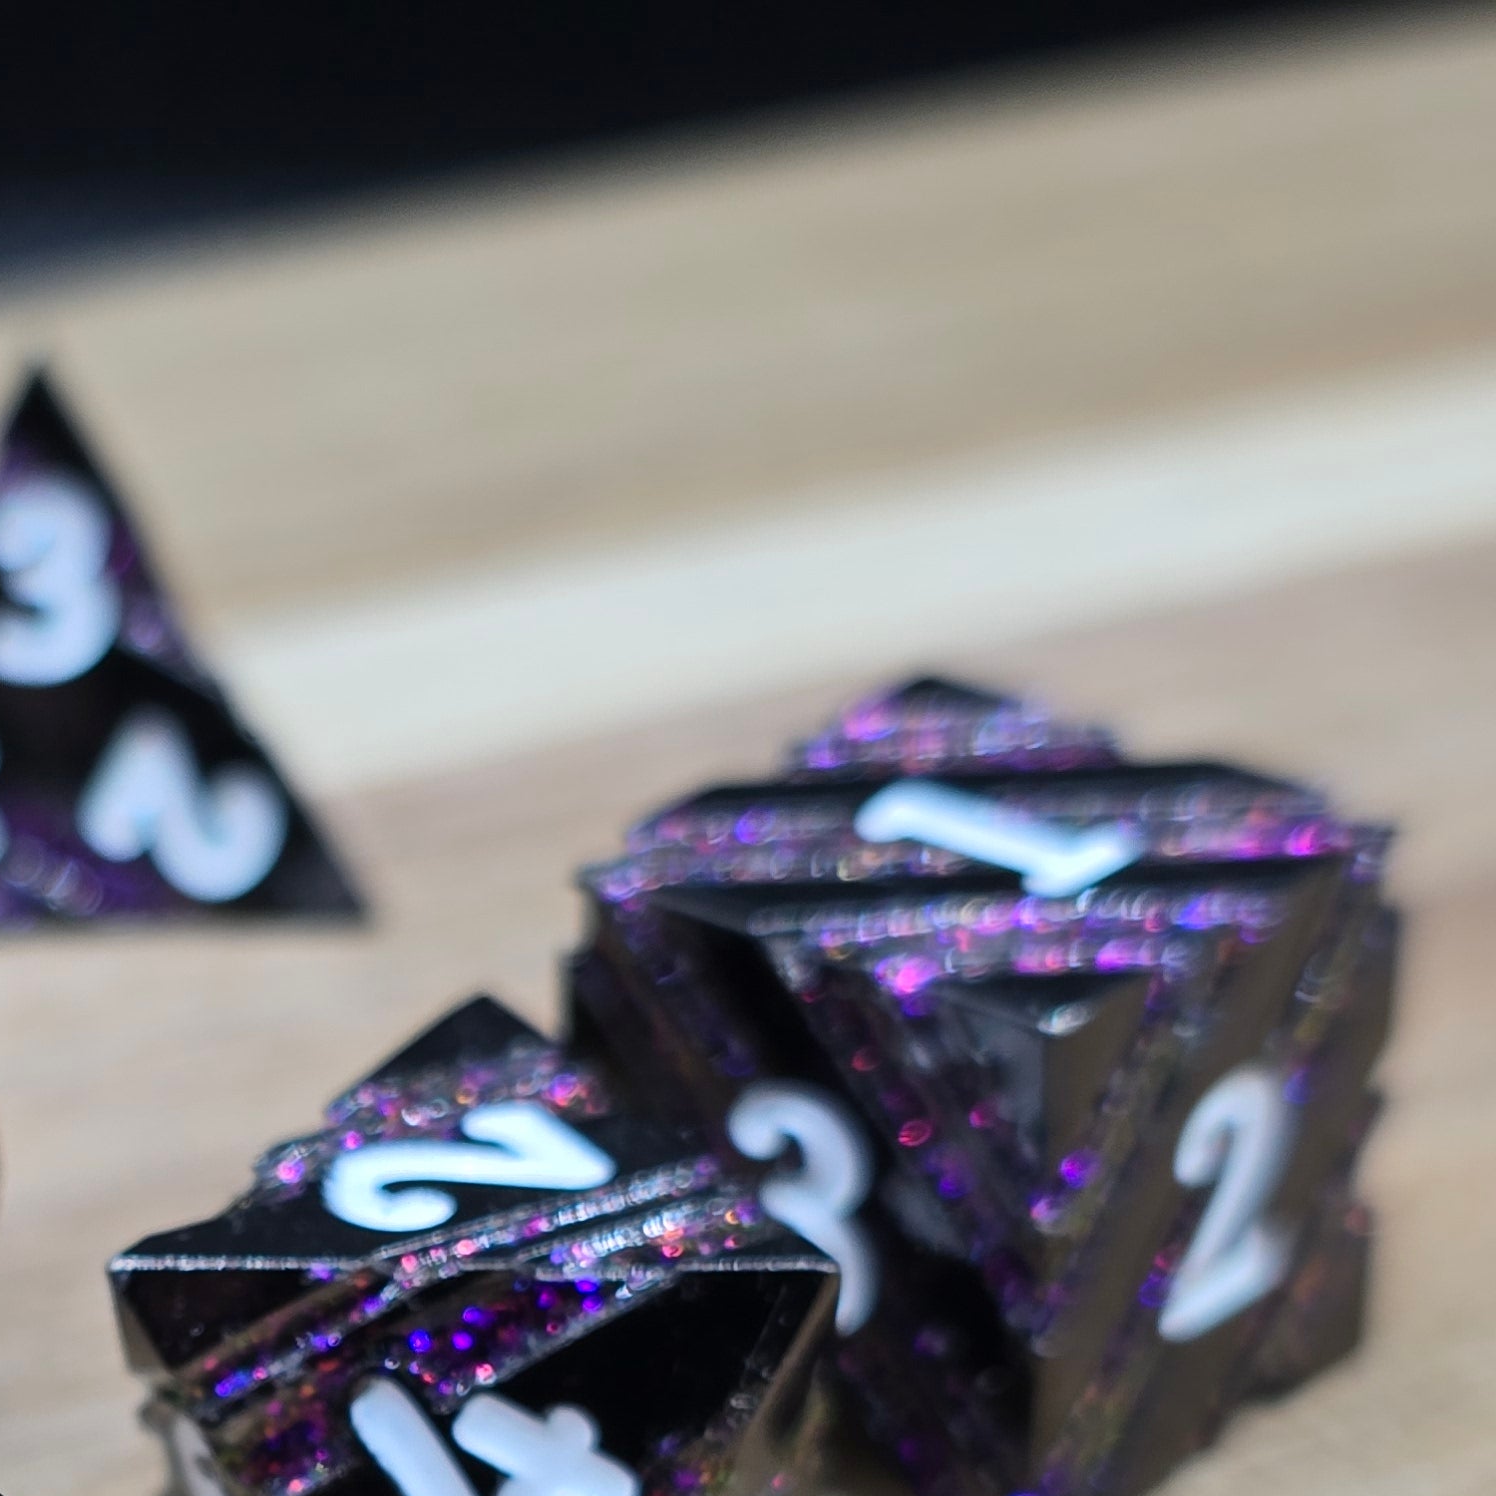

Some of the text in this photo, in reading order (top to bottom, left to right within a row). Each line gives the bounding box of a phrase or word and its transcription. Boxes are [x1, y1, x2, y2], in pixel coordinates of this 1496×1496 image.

[74, 705, 289, 904] 2
[854, 776, 1149, 899] 1
[321, 1100, 618, 1234] 2
[1159, 1066, 1298, 1342] 2
